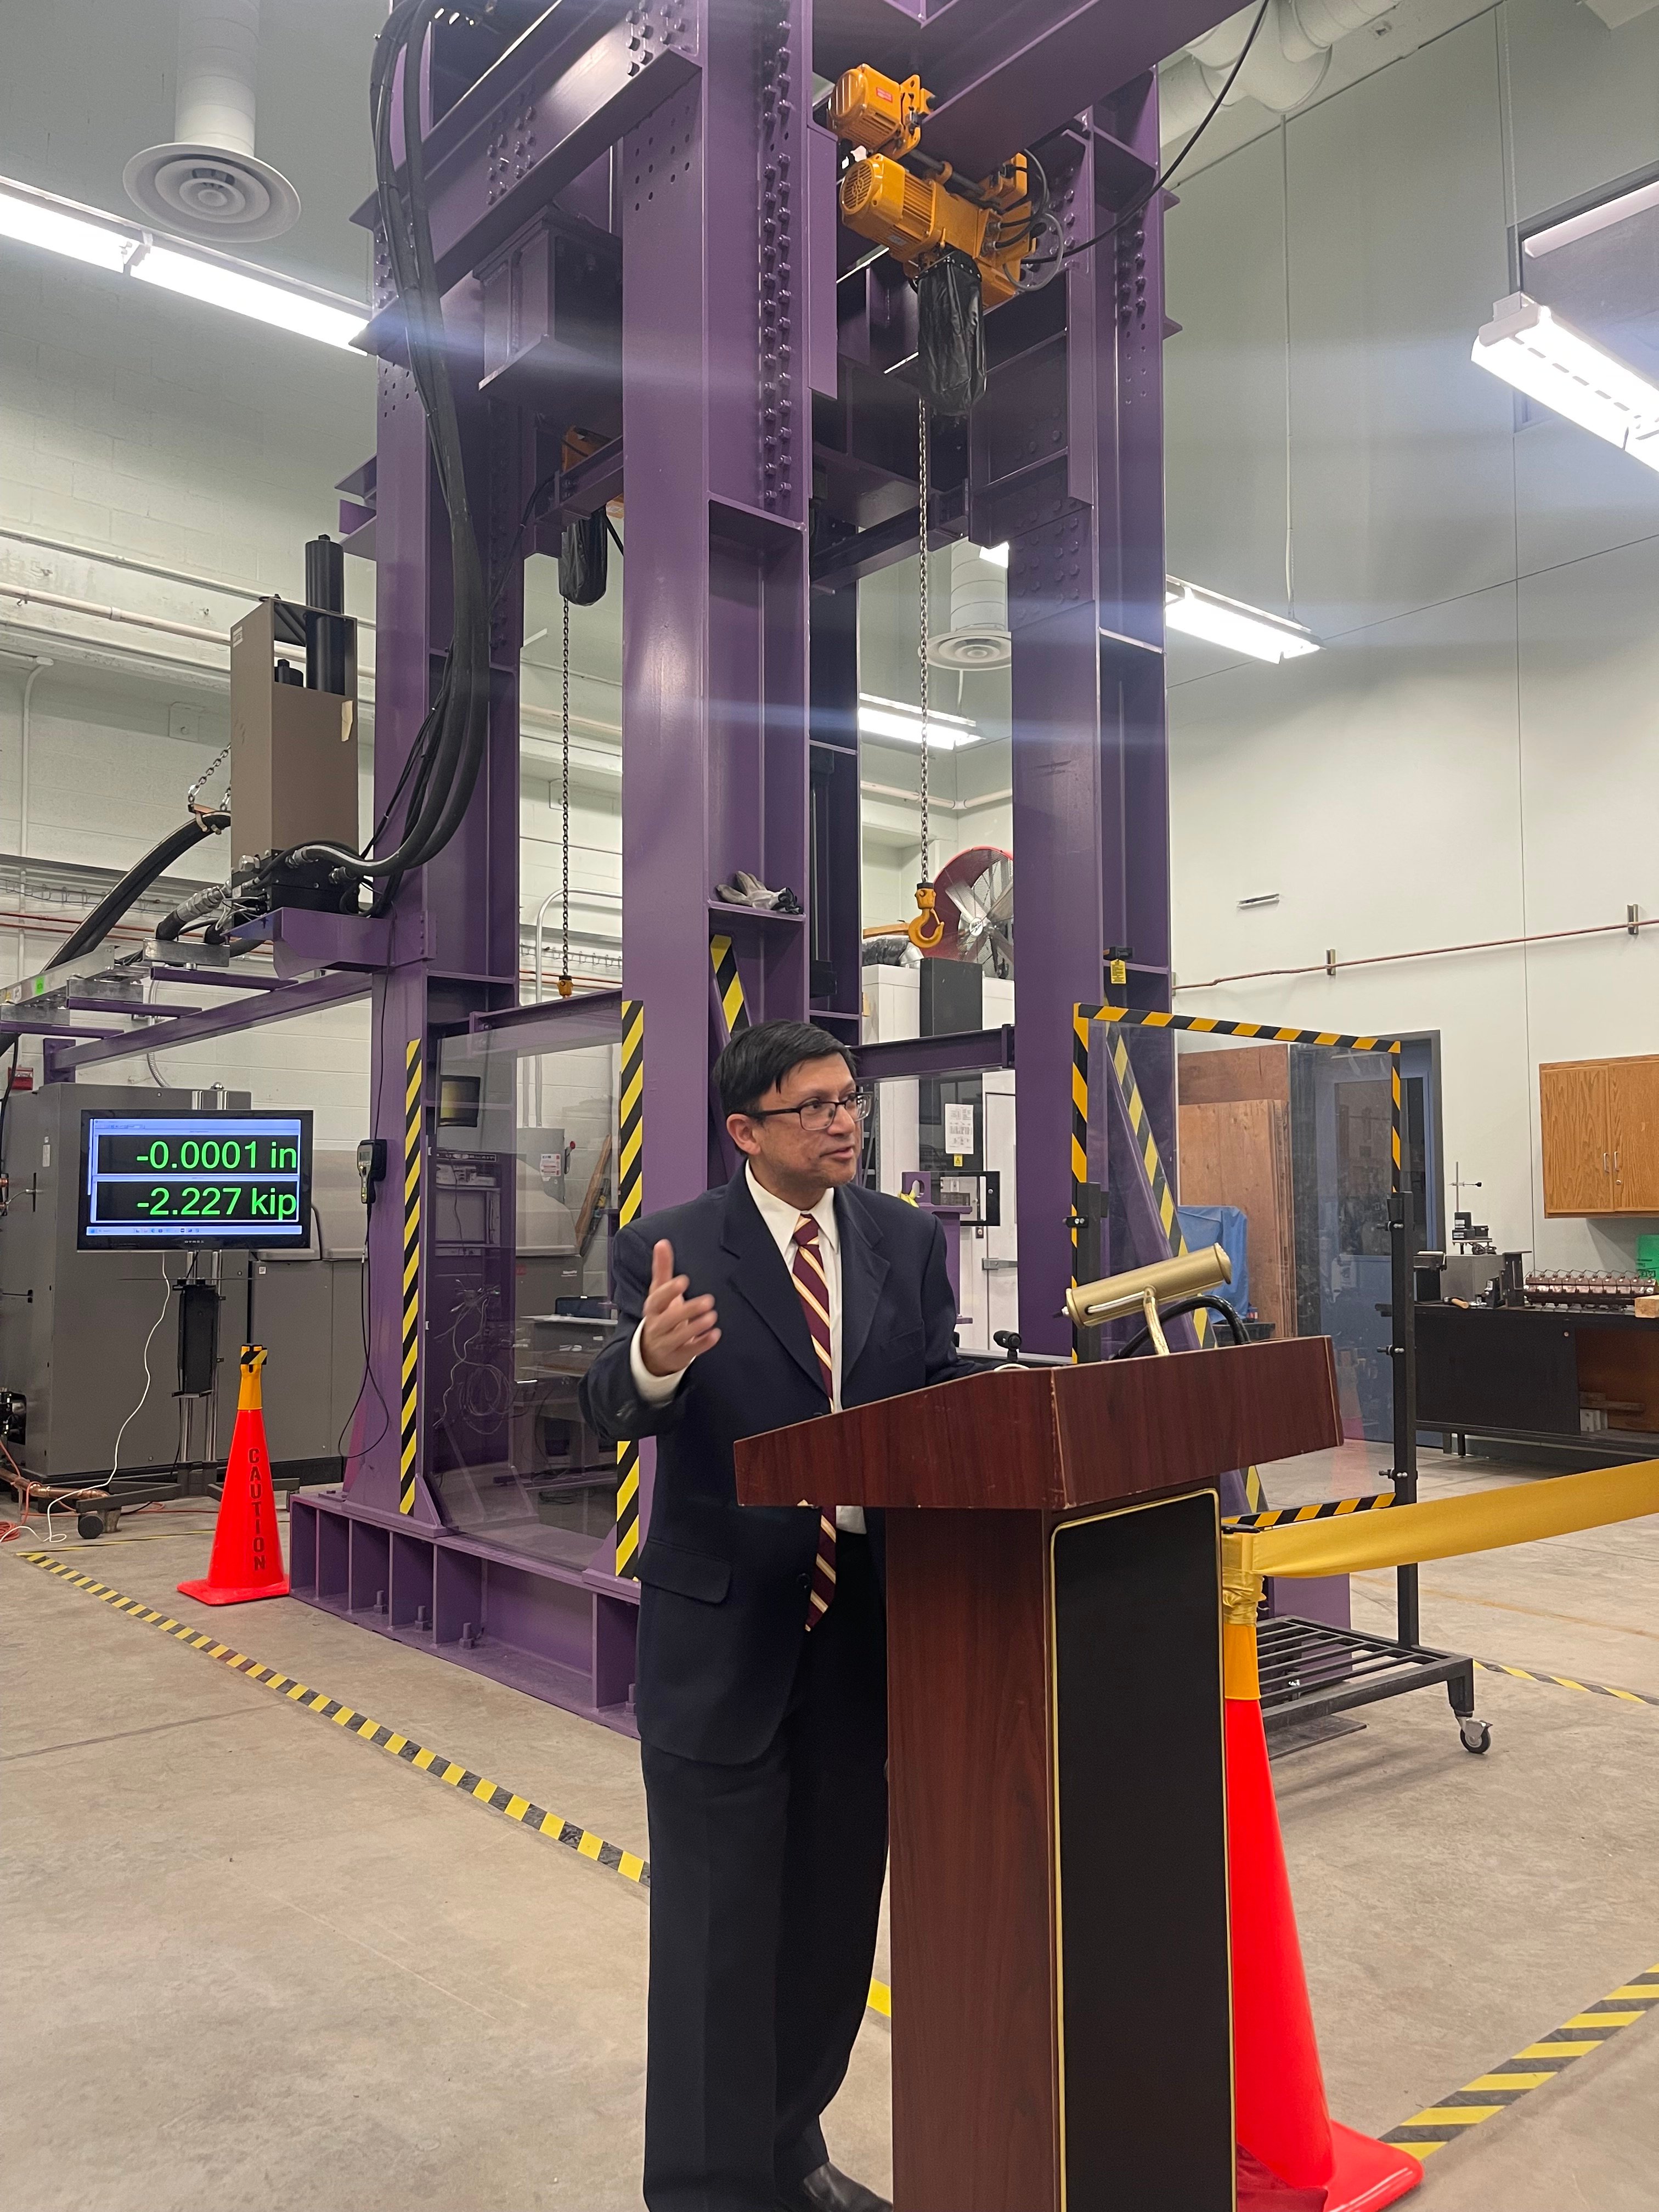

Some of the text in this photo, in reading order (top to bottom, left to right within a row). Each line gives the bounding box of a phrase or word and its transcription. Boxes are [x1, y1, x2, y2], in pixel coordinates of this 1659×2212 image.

[137, 1141, 297, 1169] -0.0001 in
[137, 1187, 297, 1220] -2.227 kip
[249, 1448, 266, 1571] CAUTION
